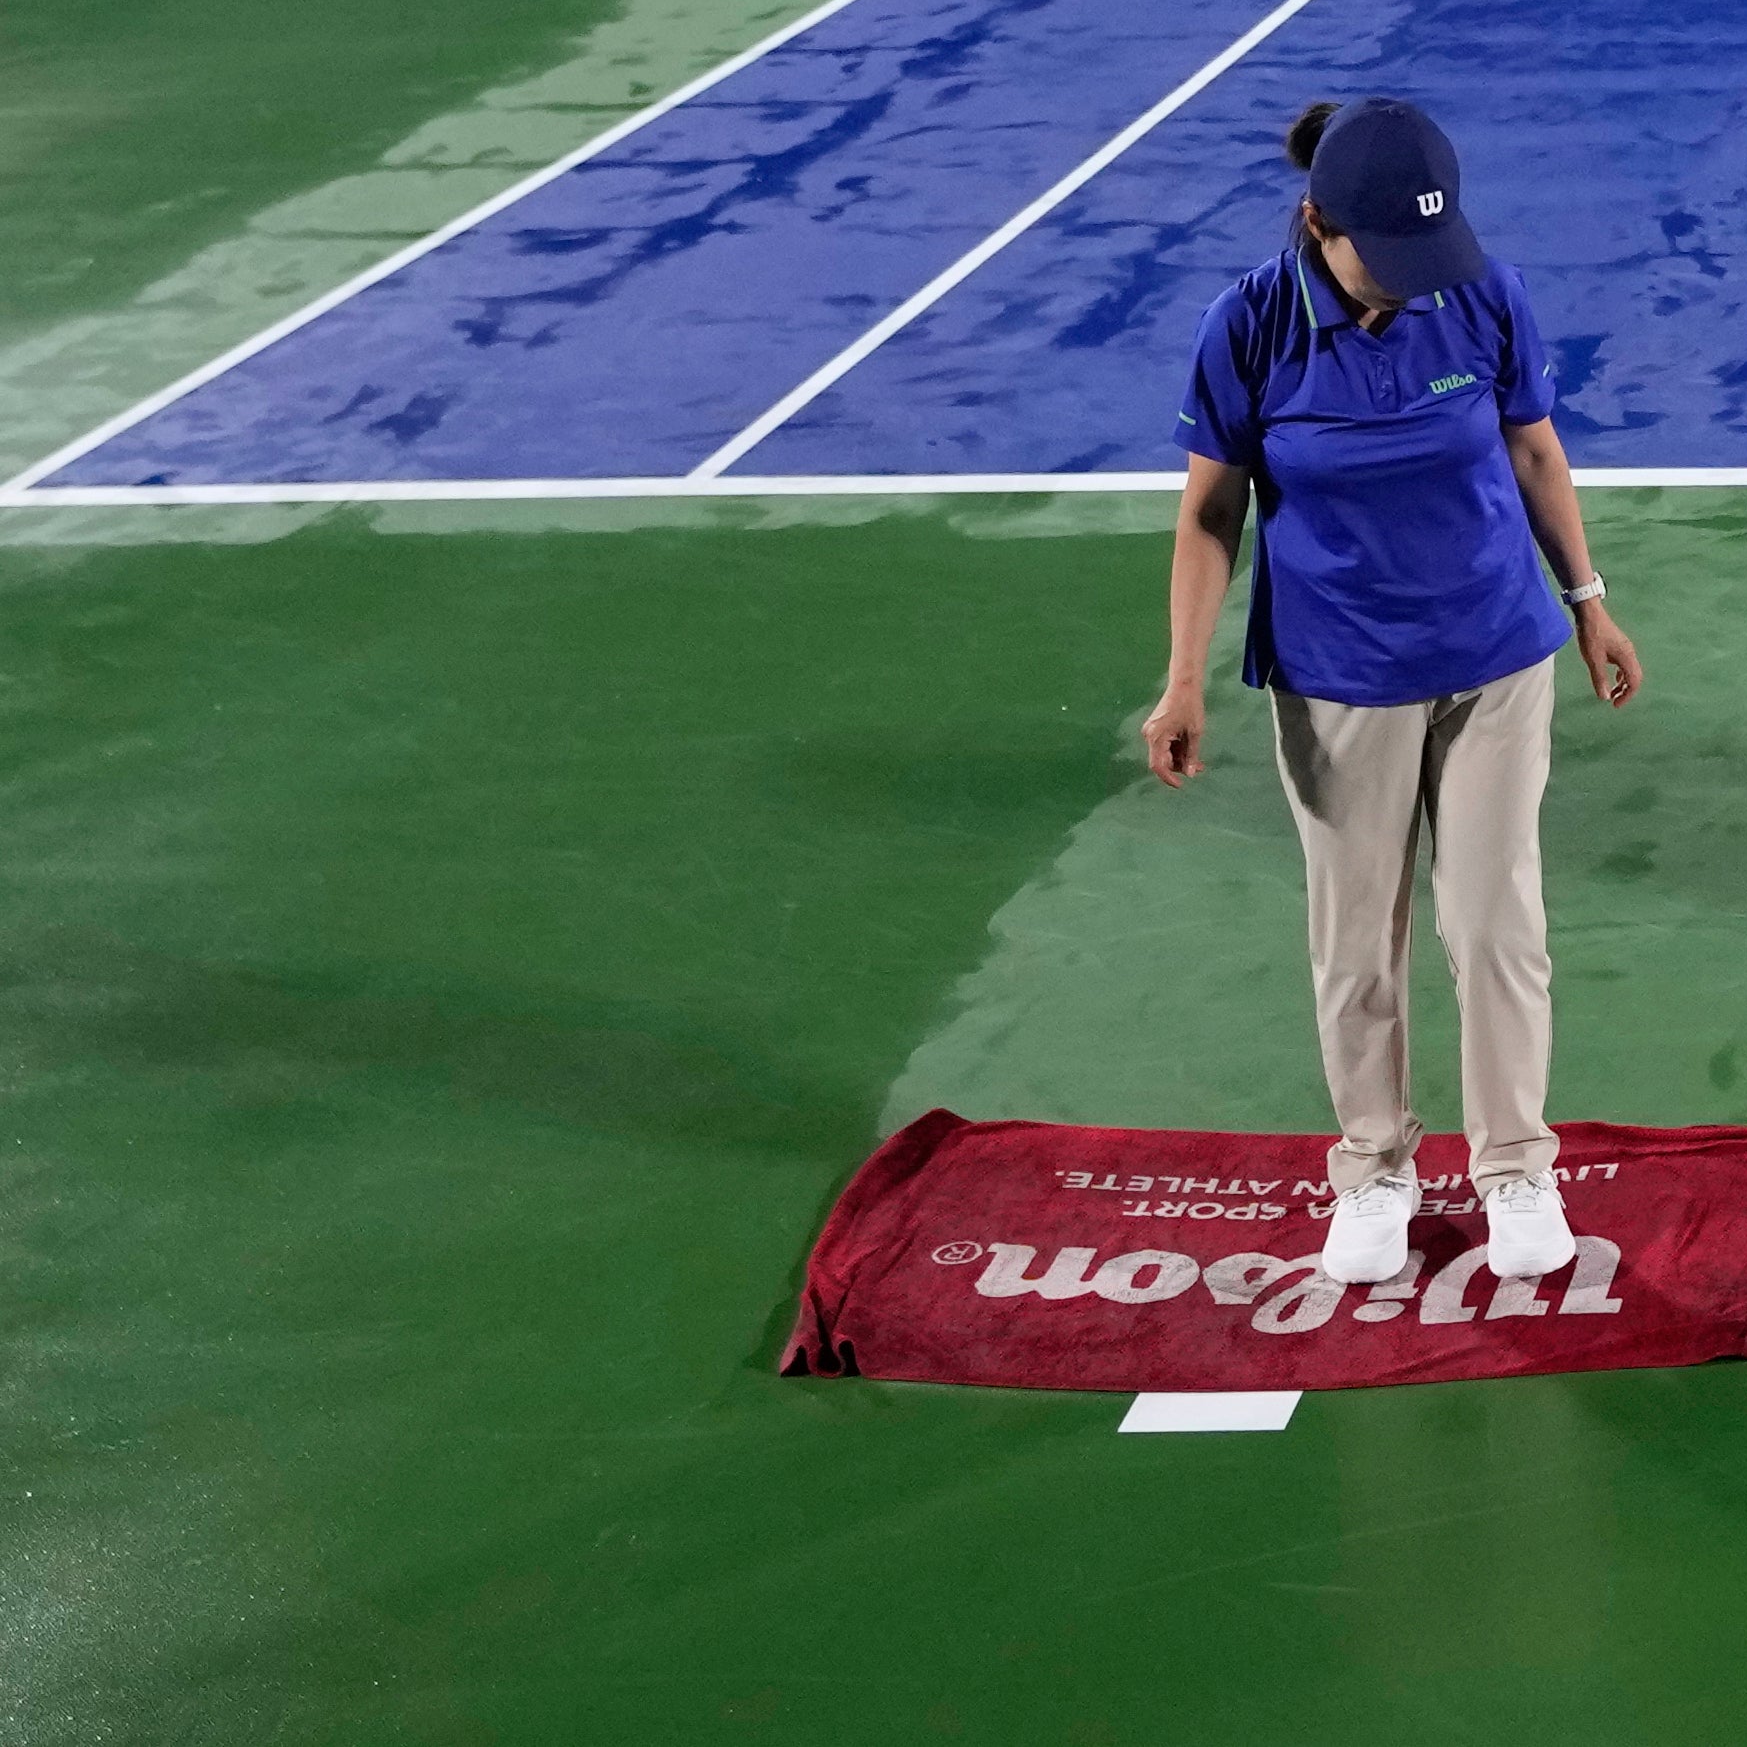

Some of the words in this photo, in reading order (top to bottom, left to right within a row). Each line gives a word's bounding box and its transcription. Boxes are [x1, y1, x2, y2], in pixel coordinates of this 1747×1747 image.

[1055, 1169, 1285, 1197] ATHLETE.
[1552, 1163, 1619, 1183] LIV
[1122, 1198, 1290, 1223] SPORT.
